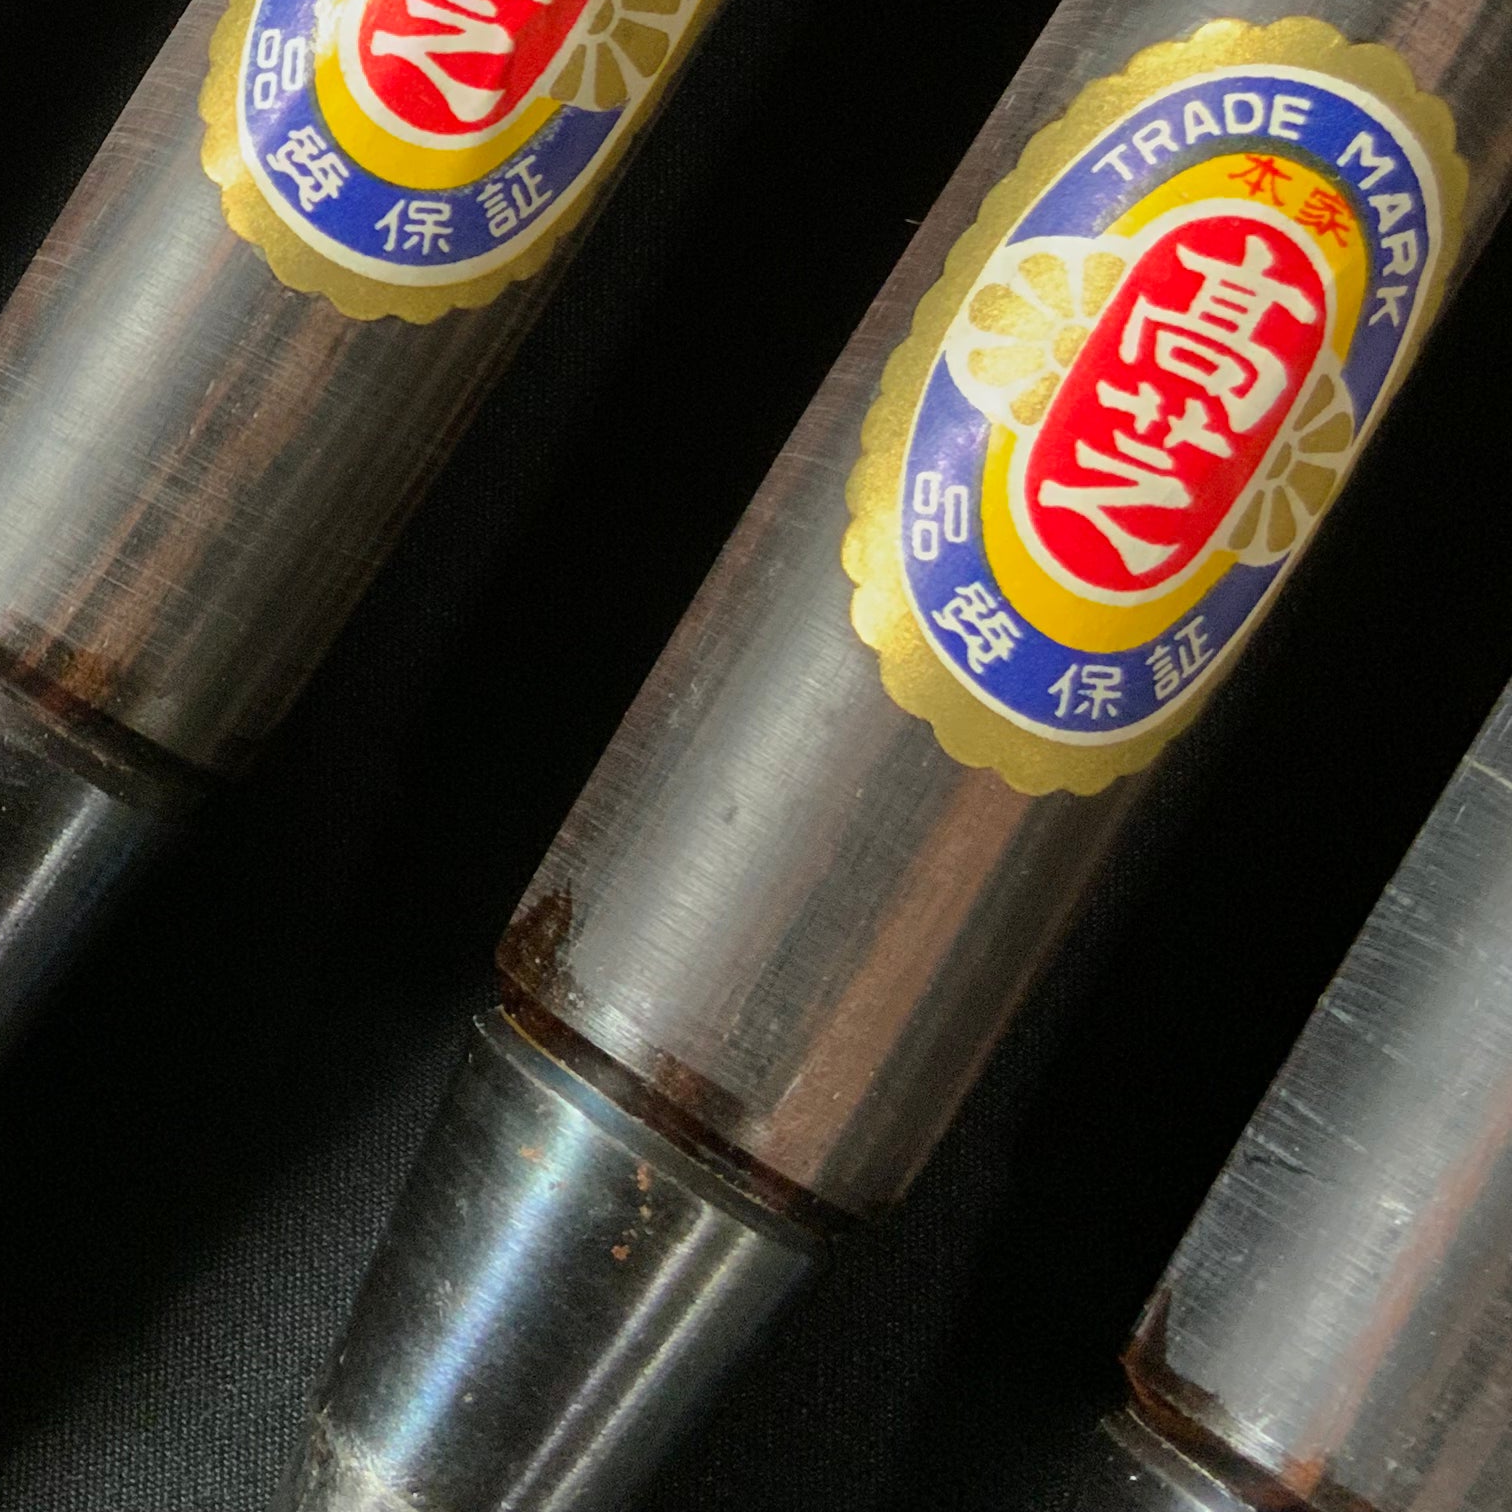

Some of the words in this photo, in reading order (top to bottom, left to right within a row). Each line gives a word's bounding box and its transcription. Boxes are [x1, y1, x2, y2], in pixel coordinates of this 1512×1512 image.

[1090, 91, 1311, 183] TRADE
[1337, 131, 1417, 329] MARK
[1229, 153, 1356, 250] 本家
